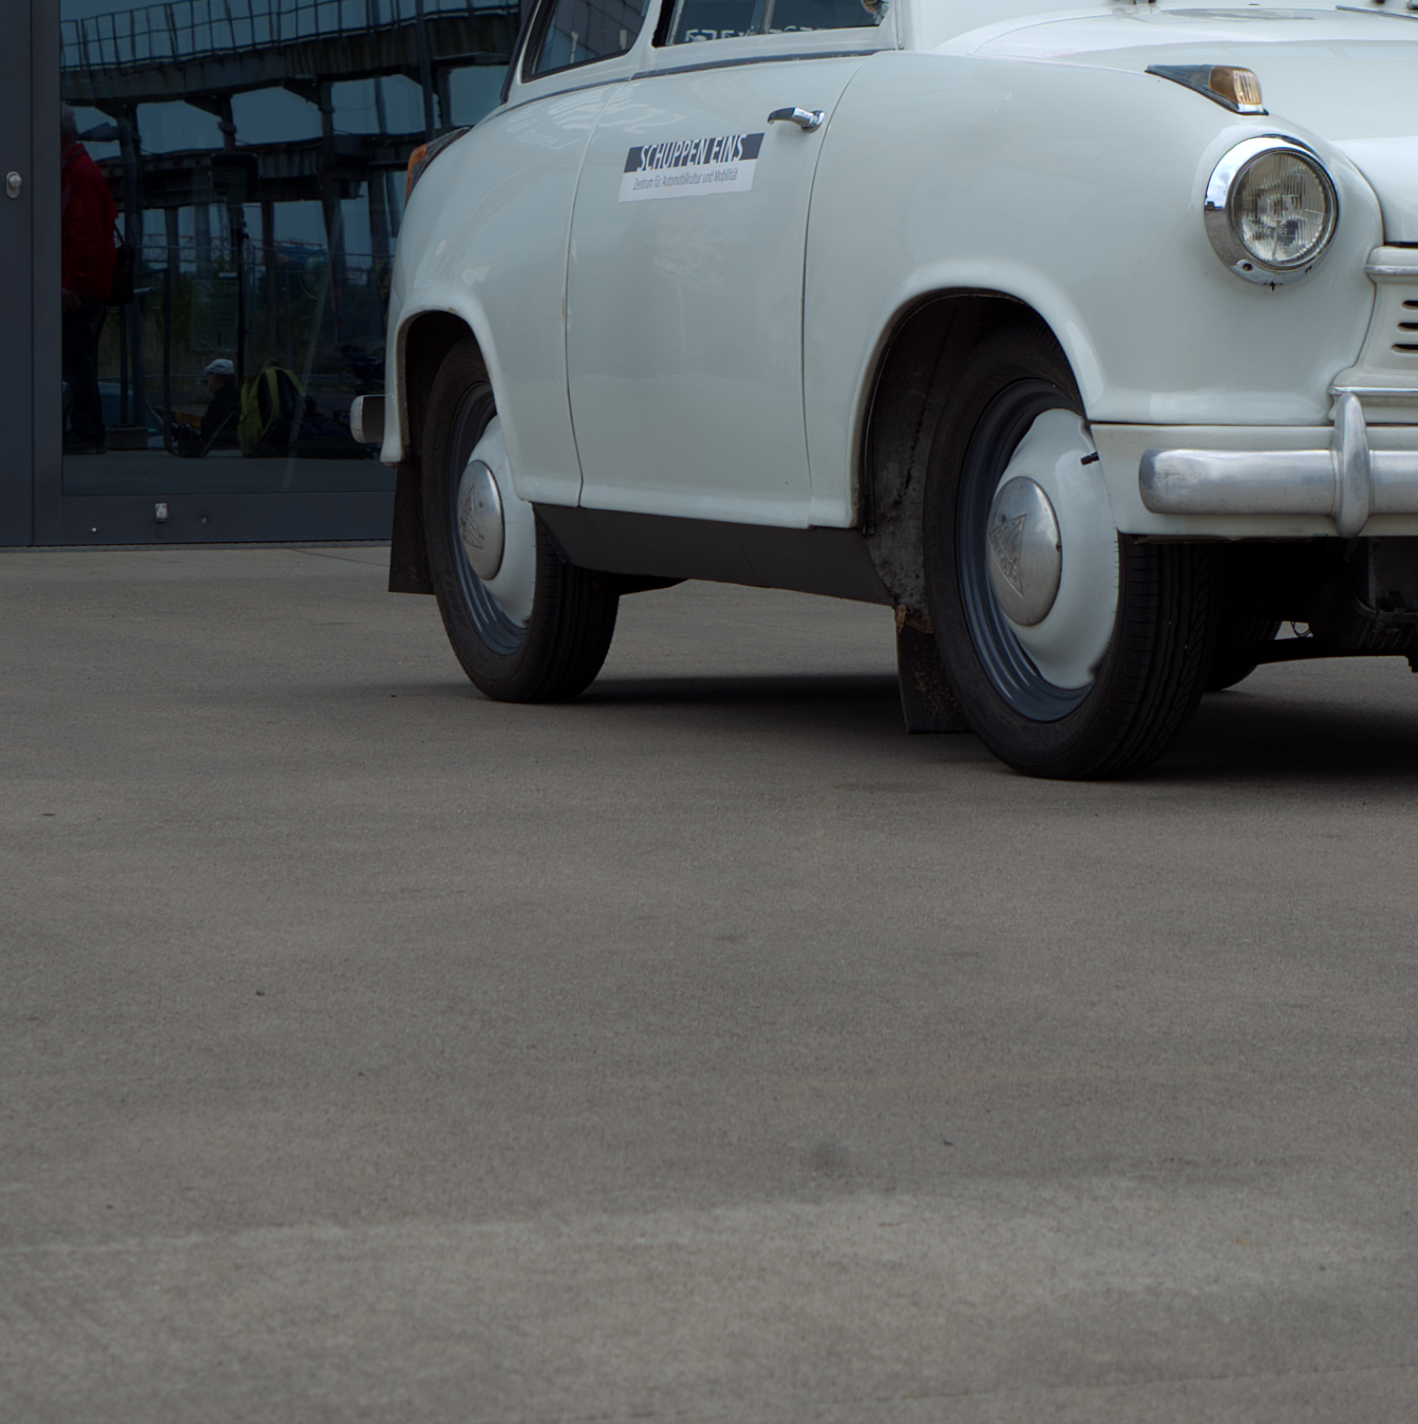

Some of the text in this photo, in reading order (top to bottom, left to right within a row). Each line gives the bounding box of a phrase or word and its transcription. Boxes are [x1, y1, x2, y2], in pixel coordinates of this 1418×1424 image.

[636, 134, 747, 171] SCHUPPEN EINS
[633, 178, 654, 191] Zentrum
[702, 171, 714, 183] und
